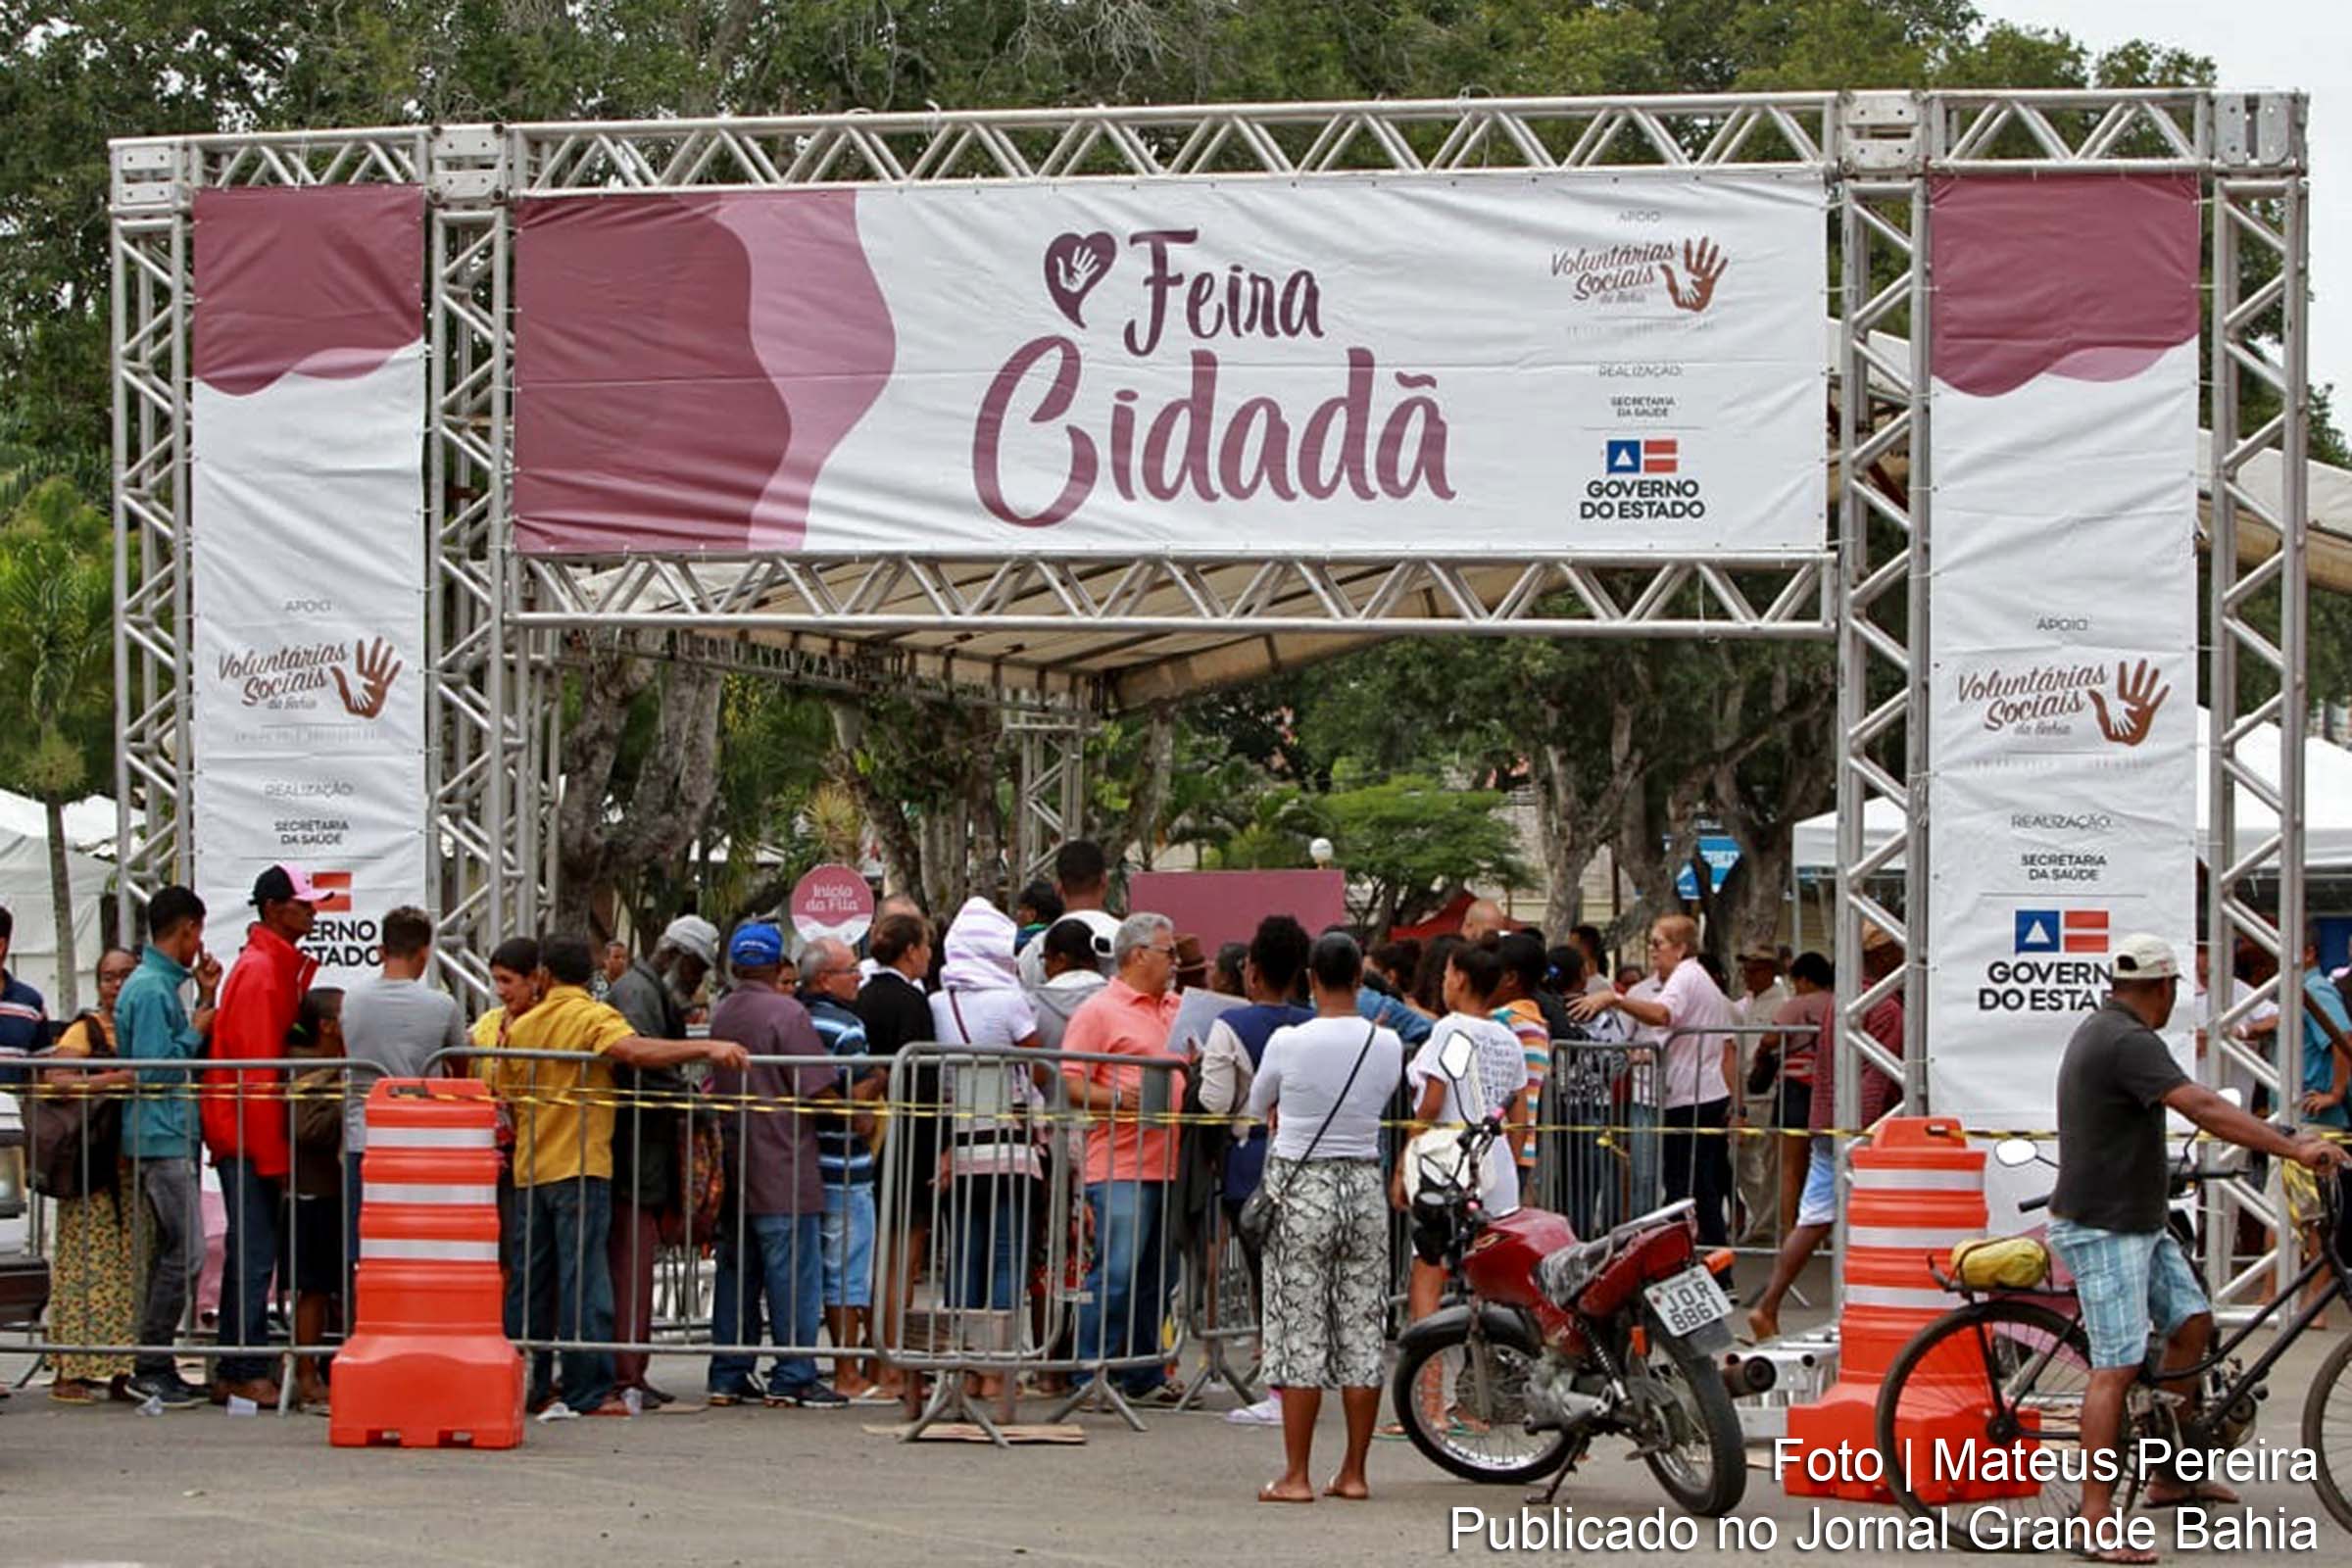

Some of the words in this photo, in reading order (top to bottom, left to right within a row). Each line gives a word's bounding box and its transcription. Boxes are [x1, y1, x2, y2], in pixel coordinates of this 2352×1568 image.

[1551, 241, 1675, 276] Voluntárias
[1124, 228, 1323, 356] Feira
[1573, 266, 1656, 301] Sociais
[1610, 396, 1676, 406] SECRETARIA
[1617, 407, 1633, 417] DA
[973, 335, 1456, 527] Cidadã
[1587, 479, 1699, 499] GOVERNO
[1580, 501, 1615, 519] DO
[1618, 500, 1705, 519] ESTADO
[219, 642, 348, 680] Voluntárias
[242, 667, 329, 706] Sociais
[1957, 662, 2107, 703] Voluntárias
[1984, 689, 2085, 731] Sociais
[274, 819, 349, 832] SECRETARIA
[280, 833, 298, 845] DA
[2021, 854, 2107, 866] SECRETARIA
[2029, 868, 2048, 881] DA
[306, 920, 376, 942] ERNO
[299, 946, 383, 966] TADO
[1987, 960, 2113, 985] GOVERN
[1979, 989, 2025, 1011] DO
[2030, 988, 2113, 1011] ESTA
[1671, 1296, 1723, 1332] 8861
